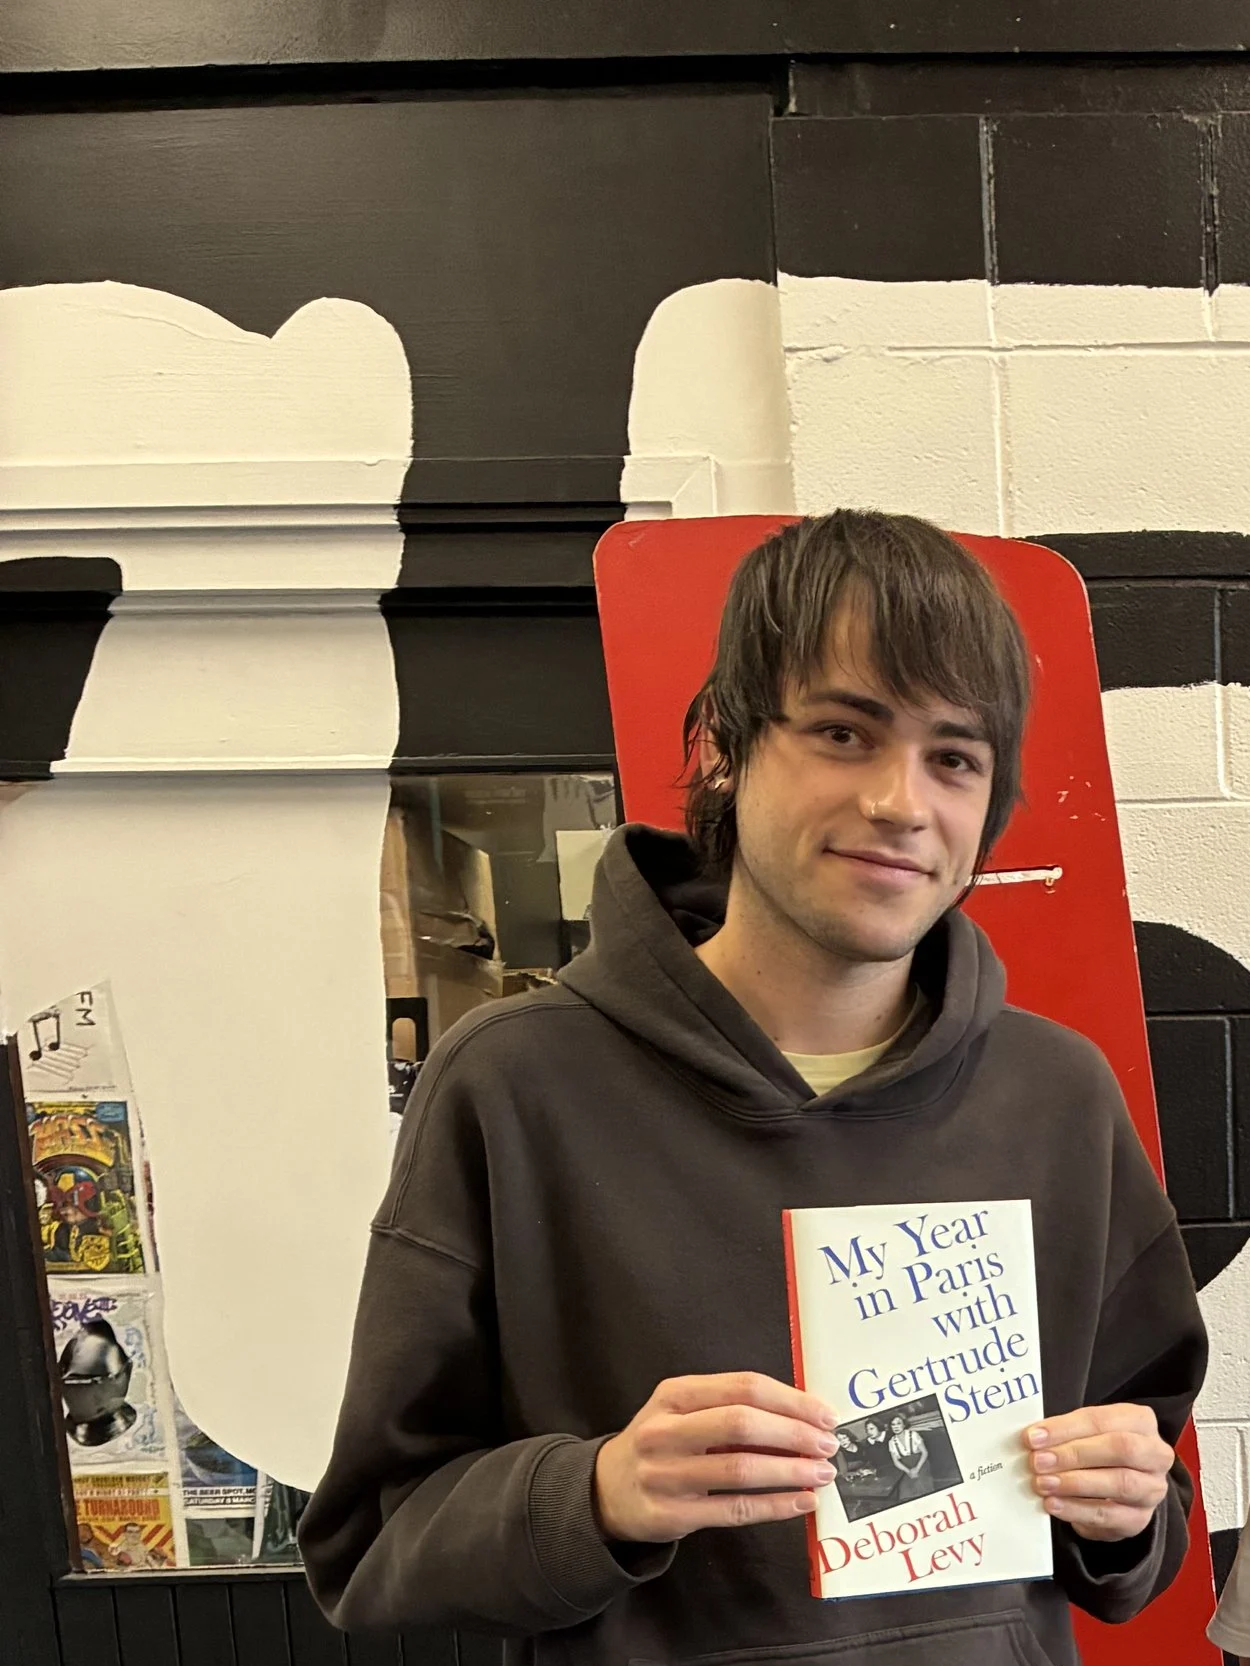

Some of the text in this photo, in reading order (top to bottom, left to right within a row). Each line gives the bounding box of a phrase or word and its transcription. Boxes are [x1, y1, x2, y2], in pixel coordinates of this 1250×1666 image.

[819, 1209, 989, 1285] My Year
[852, 1244, 1004, 1321] in Paris
[932, 1285, 1018, 1338] with
[848, 1327, 1029, 1409] Gertrude
[945, 1367, 1040, 1423] Stein
[199, 1488, 221, 1496] BEER
[969, 1462, 1003, 1481] a fiction
[83, 1499, 160, 1516] TURNAROUND
[818, 1493, 978, 1575] Deborah
[899, 1533, 985, 1582] Levy
